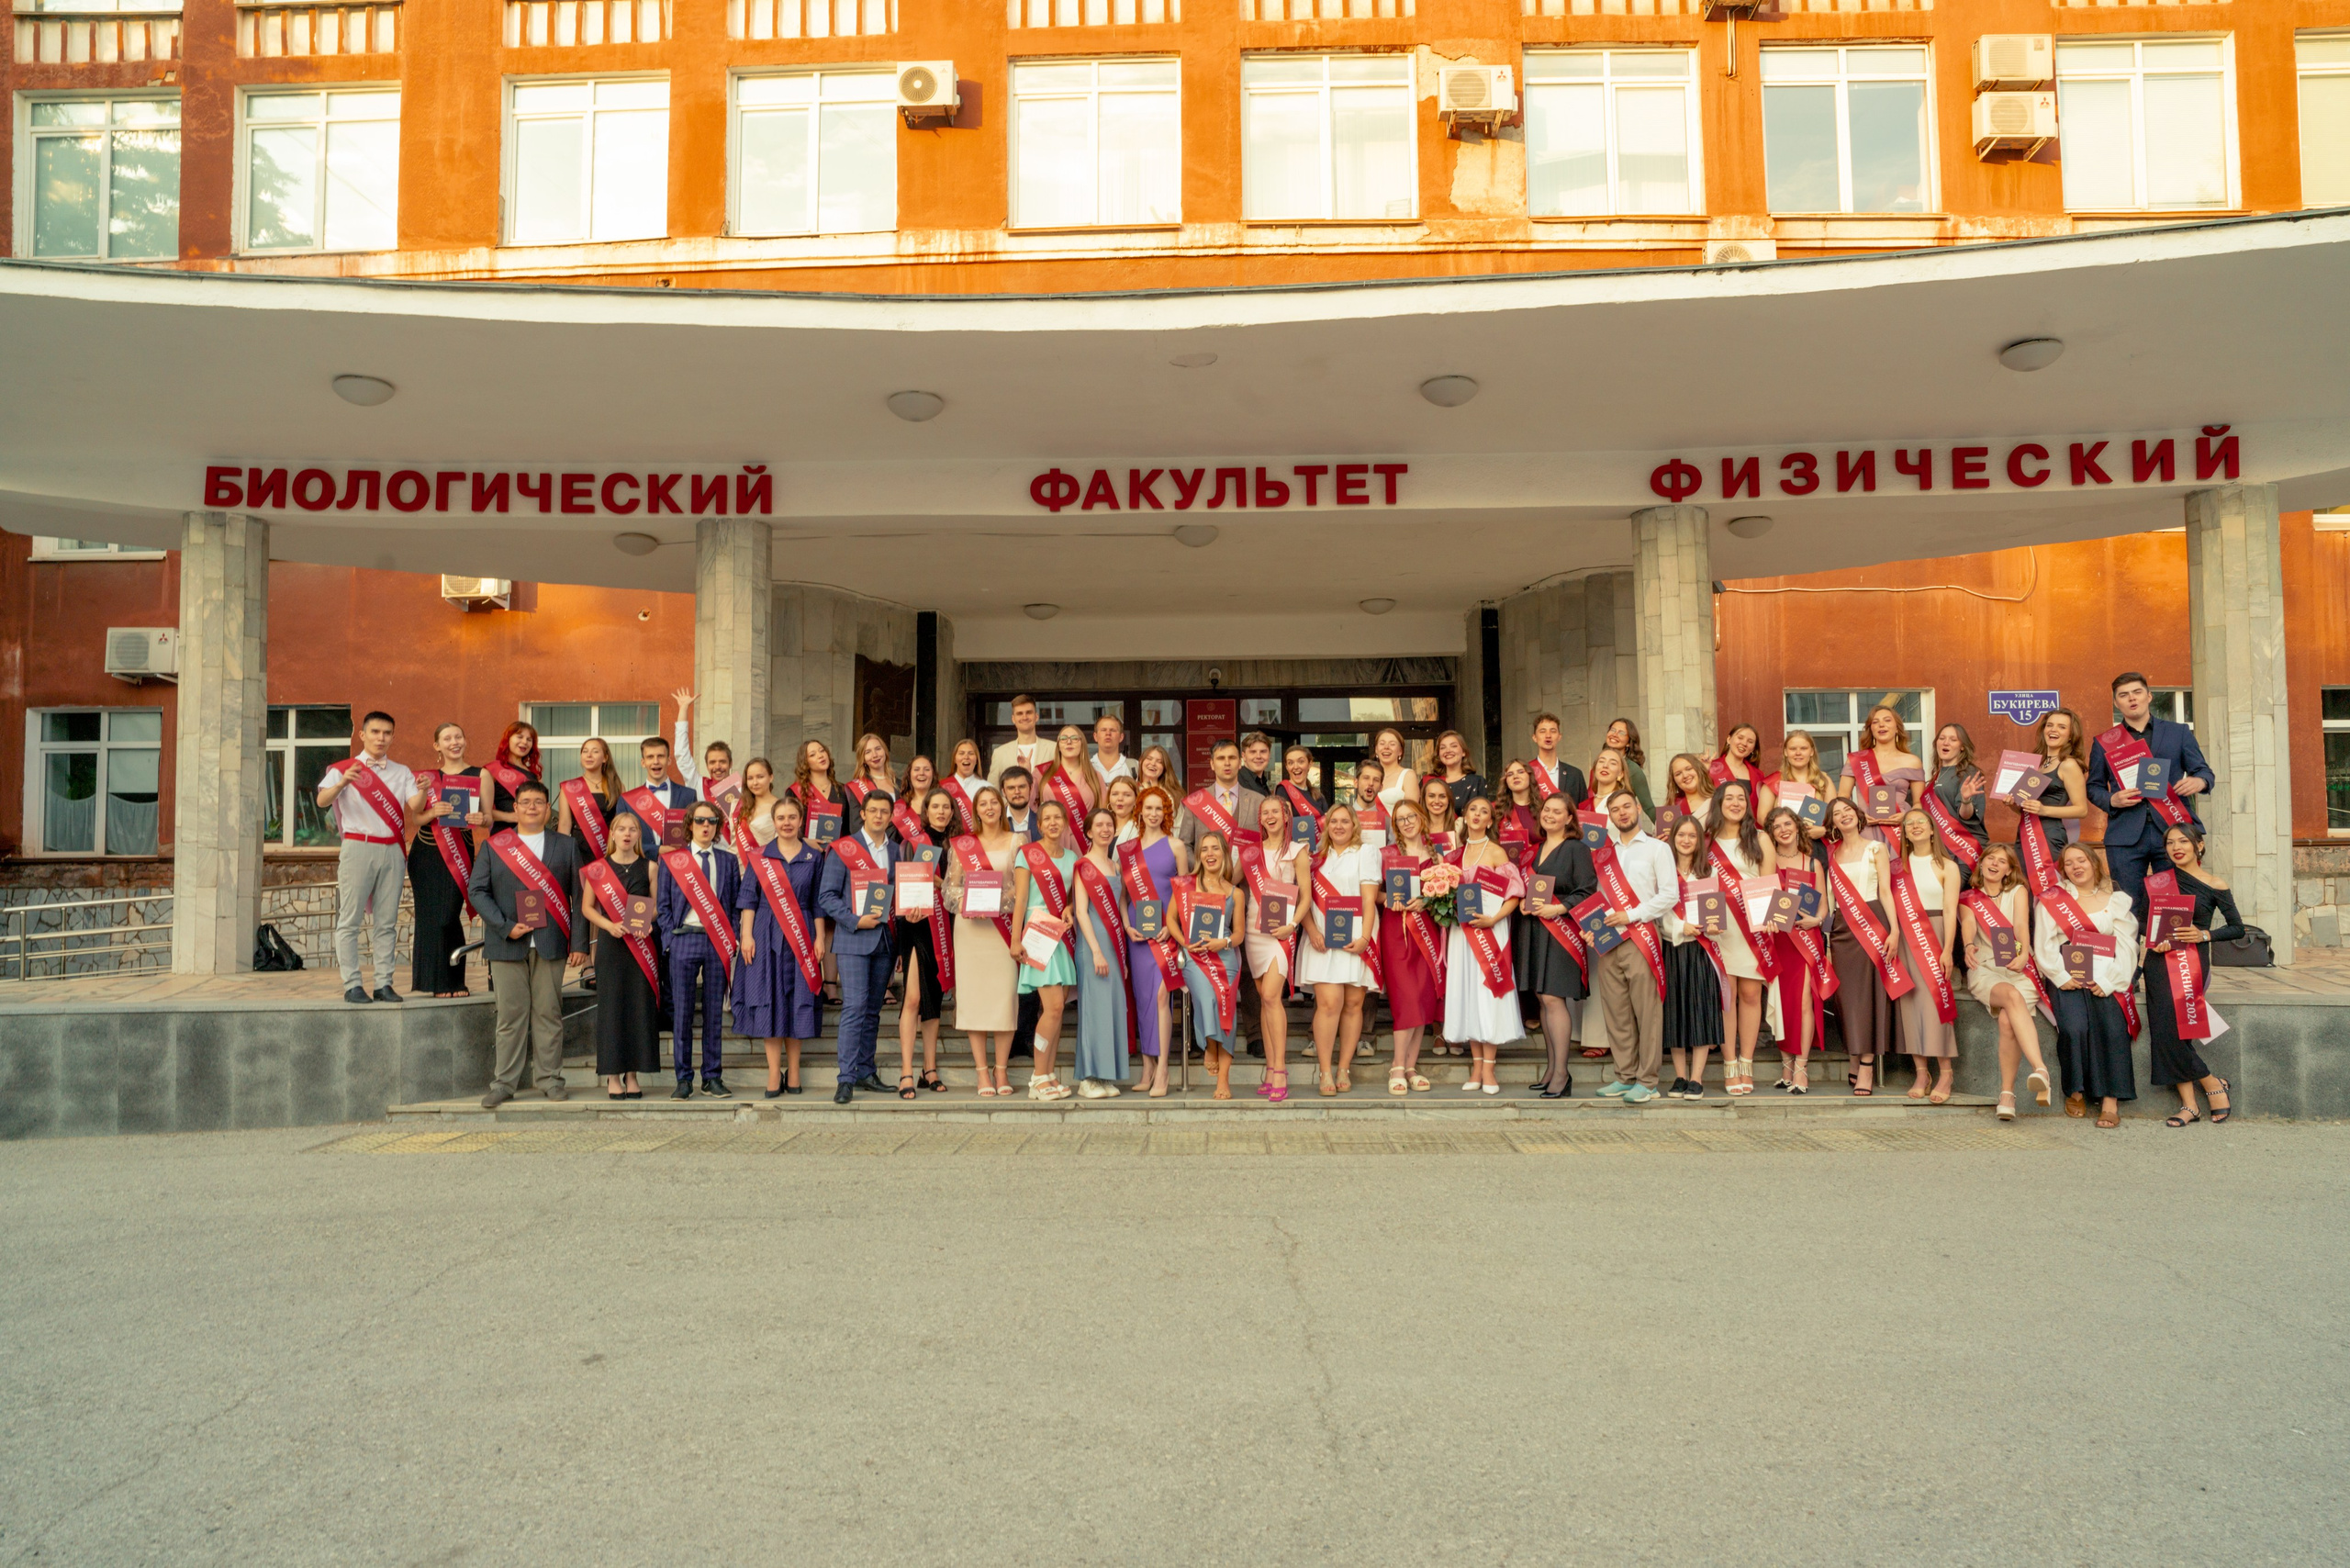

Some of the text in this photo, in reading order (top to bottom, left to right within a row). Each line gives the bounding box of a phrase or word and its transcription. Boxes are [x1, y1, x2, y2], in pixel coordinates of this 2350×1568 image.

[1650, 424, 2240, 503] ФИЗИЧЕСКИЙ
[204, 465, 773, 515] БИОЛОГИЧЕСКИЙ
[1029, 464, 1408, 512] ФАКУЛЬТЕТ
[1993, 700, 2056, 710] БУКИРЕВА
[2020, 710, 2032, 721] 15
[1054, 776, 1074, 809] ЛУЧШИЙ
[1860, 761, 1875, 787] ЛУЧШ
[372, 790, 403, 828] ЛУЧШИЙ
[576, 796, 600, 837] ЛУЧШИЙ
[902, 816, 919, 836] ЛУЧШ
[1924, 792, 1980, 862] ЛУЧШИЙ ВЫПУСК
[968, 854, 983, 871] ЛУЧ
[1251, 864, 1263, 892] ЛУЧШ
[2037, 868, 2048, 892] 2024
[508, 846, 571, 929] ЛУЧШИЙ ВЫПУСКНИ
[602, 882, 625, 919] ЛУЧШИ
[1604, 864, 1628, 905] ЛУЧШИЙ
[685, 871, 734, 962] ЛУЧШИЙ ВЫПУСКН
[761, 857, 816, 979] ЛУЧШИЙ ВЫПУСКНИК 2024
[1094, 884, 1118, 927] ЛУЧШИЙ
[1128, 855, 1147, 895] ЛУЧШИЙ
[1165, 956, 1178, 977] 2024
[1707, 851, 1736, 890] ЛУЧШИЙ
[1760, 946, 1773, 968] 2024
[1973, 901, 2000, 927] ЛУЧШ
[2056, 902, 2085, 931] ЛУЧШ
[1411, 911, 1437, 965] ЫПУСКНИК
[1473, 926, 1504, 983] СКНИК 2024
[1552, 915, 1584, 956] ПУСКНИК
[1897, 879, 1950, 1009] ЛУЧШИЙ ВЫПУСКНИК 2024
[943, 957, 951, 978] 2024
[1817, 962, 1830, 984] 2024
[1886, 962, 1901, 984] 2024
[2177, 949, 2197, 1025] ПУСКНИК 2024
